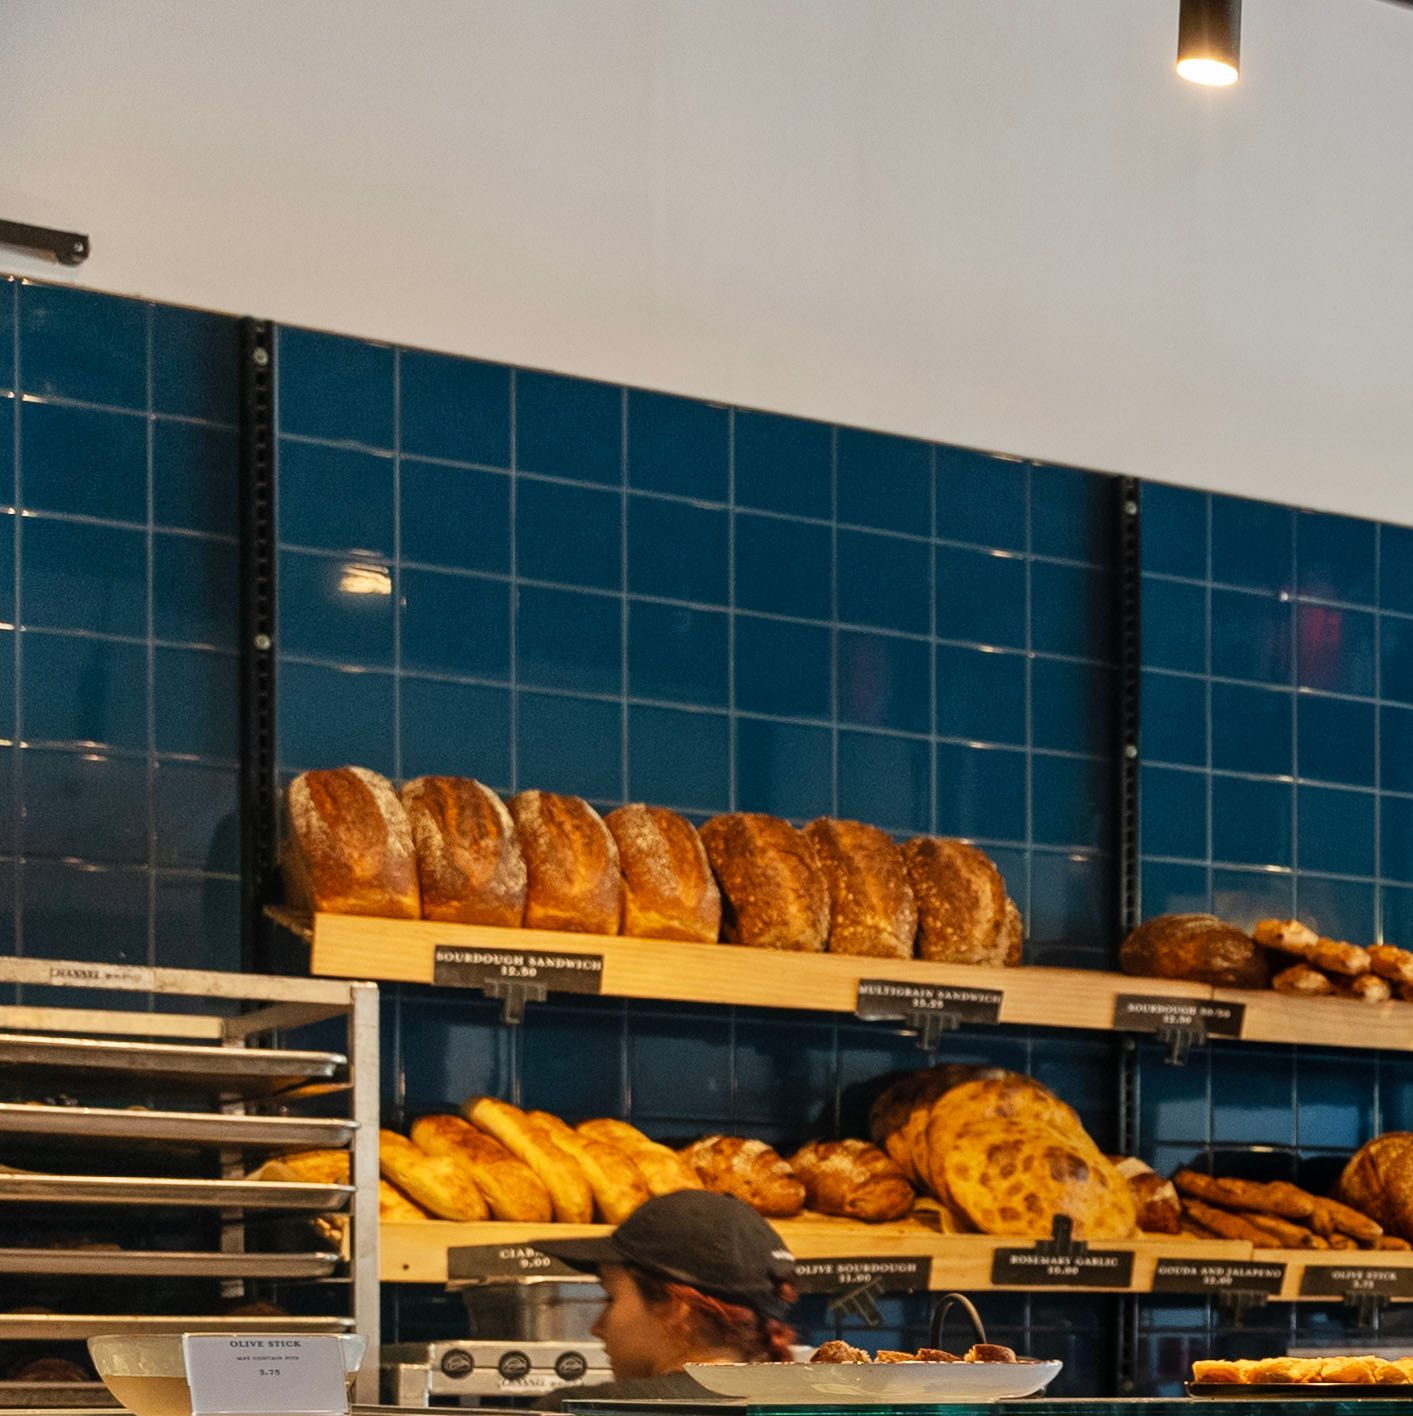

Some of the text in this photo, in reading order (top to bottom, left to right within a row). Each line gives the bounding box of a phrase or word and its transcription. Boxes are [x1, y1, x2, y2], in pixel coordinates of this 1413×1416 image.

[436, 951, 602, 971] SOURDOUGH SANDWICH
[859, 984, 935, 998] MULTIGRAIN
[937, 990, 1001, 1004] SANDWICH
[1127, 1002, 1197, 1016] SOURDOUGH
[1009, 1255, 1118, 1267] ROSEMARY GARLIC
[795, 1262, 917, 1275] OLIVE SOURDOUGH
[1158, 1265, 1197, 1276] GOUDA
[1201, 1267, 1224, 1276] AND
[1331, 1270, 1397, 1281] OLIVE STICK
[230, 1340, 301, 1348] OLIVE STICK
